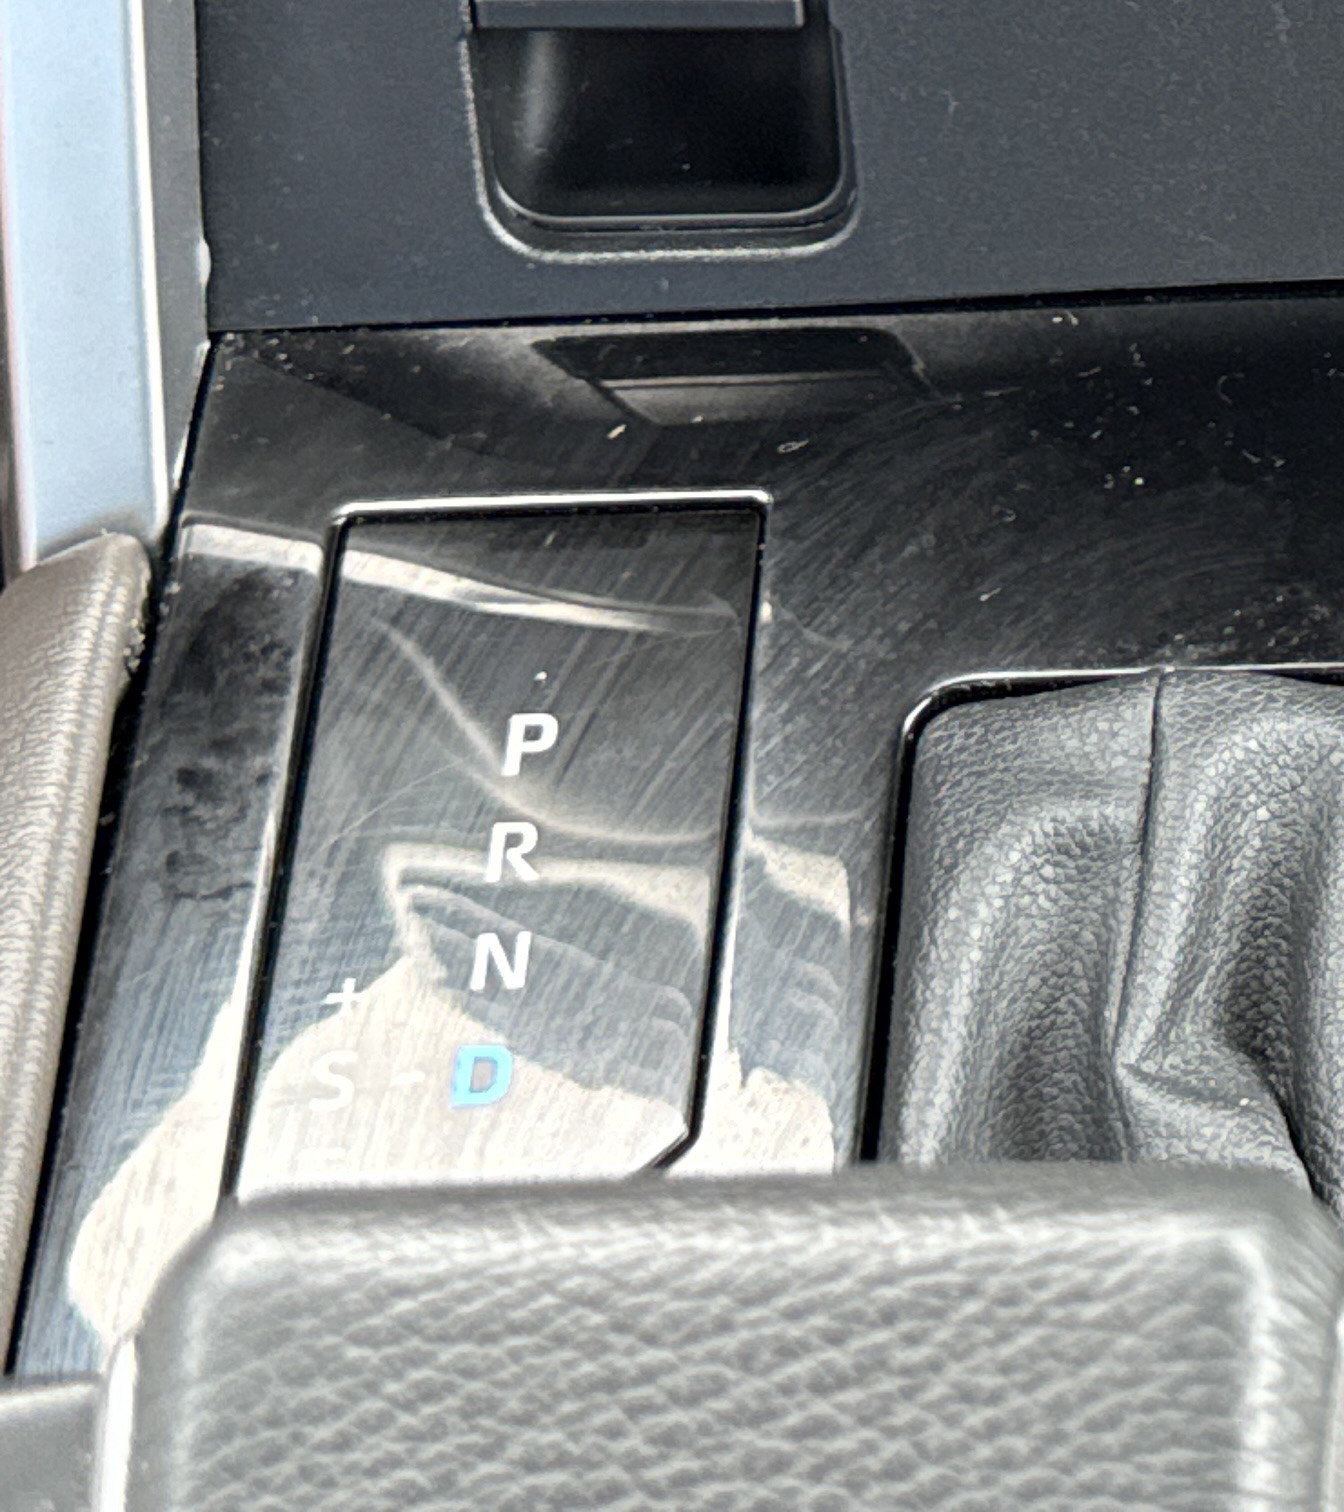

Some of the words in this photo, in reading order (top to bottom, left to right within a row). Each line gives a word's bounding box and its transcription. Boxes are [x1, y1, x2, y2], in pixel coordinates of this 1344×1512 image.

[501, 712, 559, 776] P
[485, 822, 540, 883] R
[470, 930, 532, 992] N
[308, 1049, 358, 1112] S
[450, 1043, 514, 1109] D
